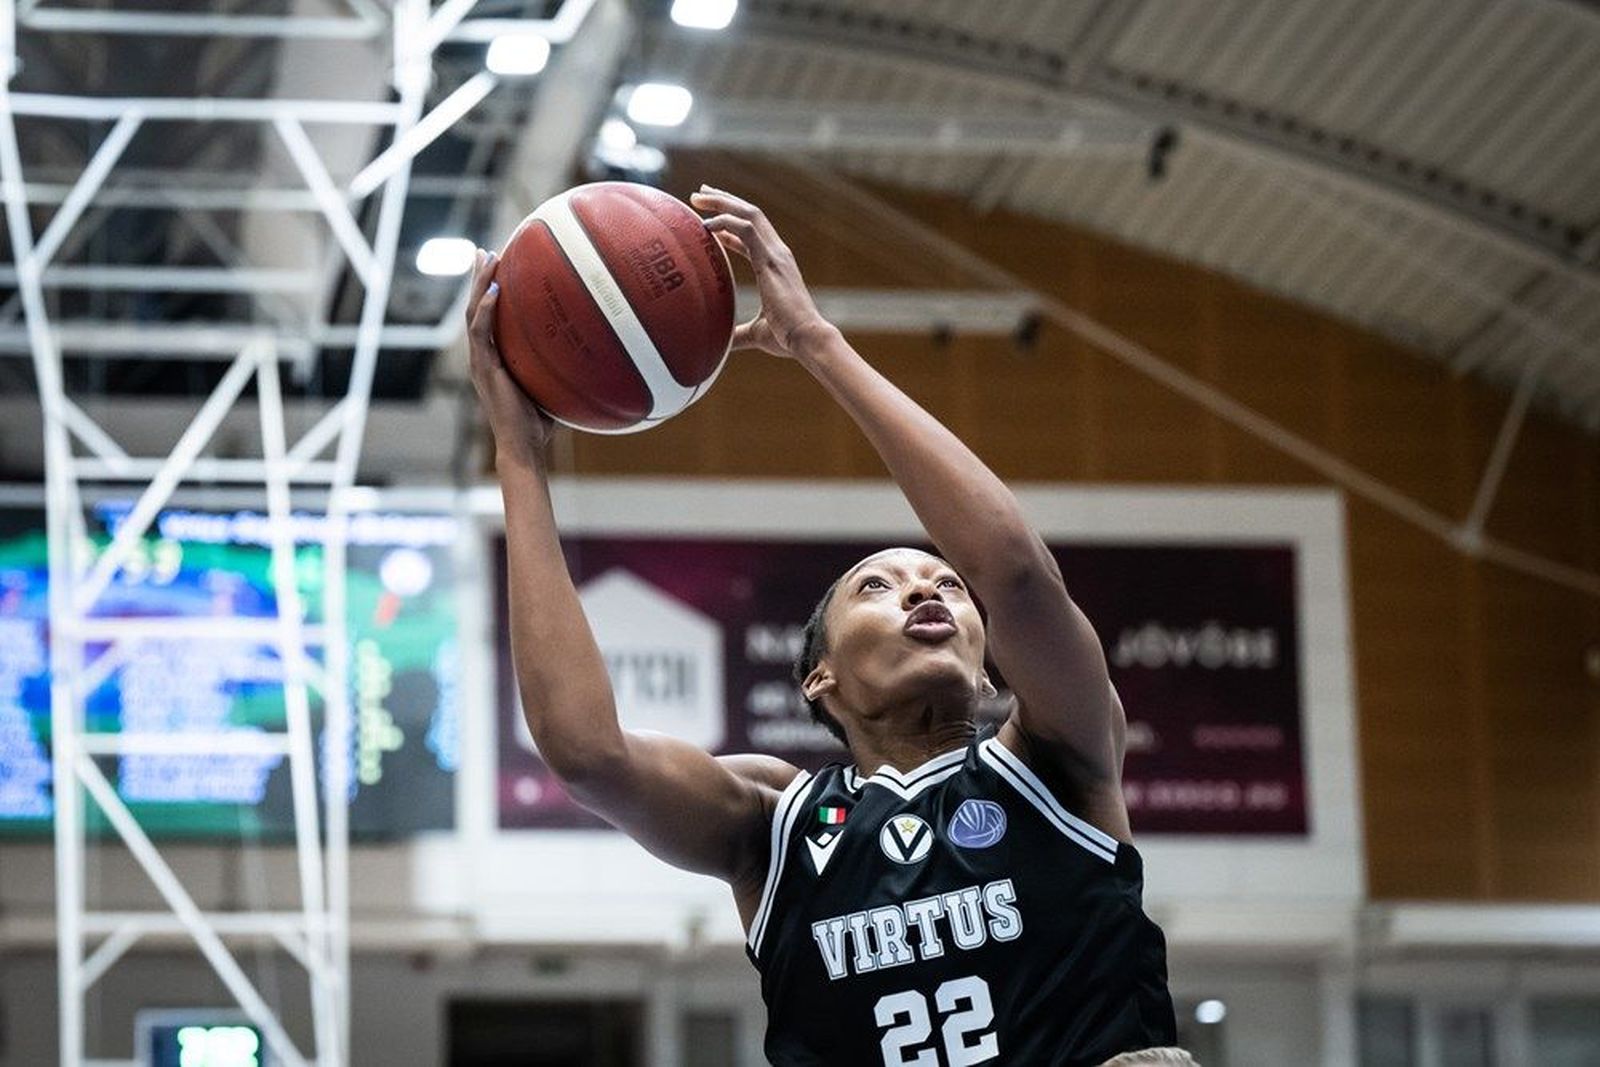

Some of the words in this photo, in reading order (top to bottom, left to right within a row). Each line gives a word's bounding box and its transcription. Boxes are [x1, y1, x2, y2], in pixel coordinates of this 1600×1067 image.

[644, 238, 685, 292] FIBA
[812, 878, 1024, 980] VIRTUS
[873, 975, 999, 1067] 22
